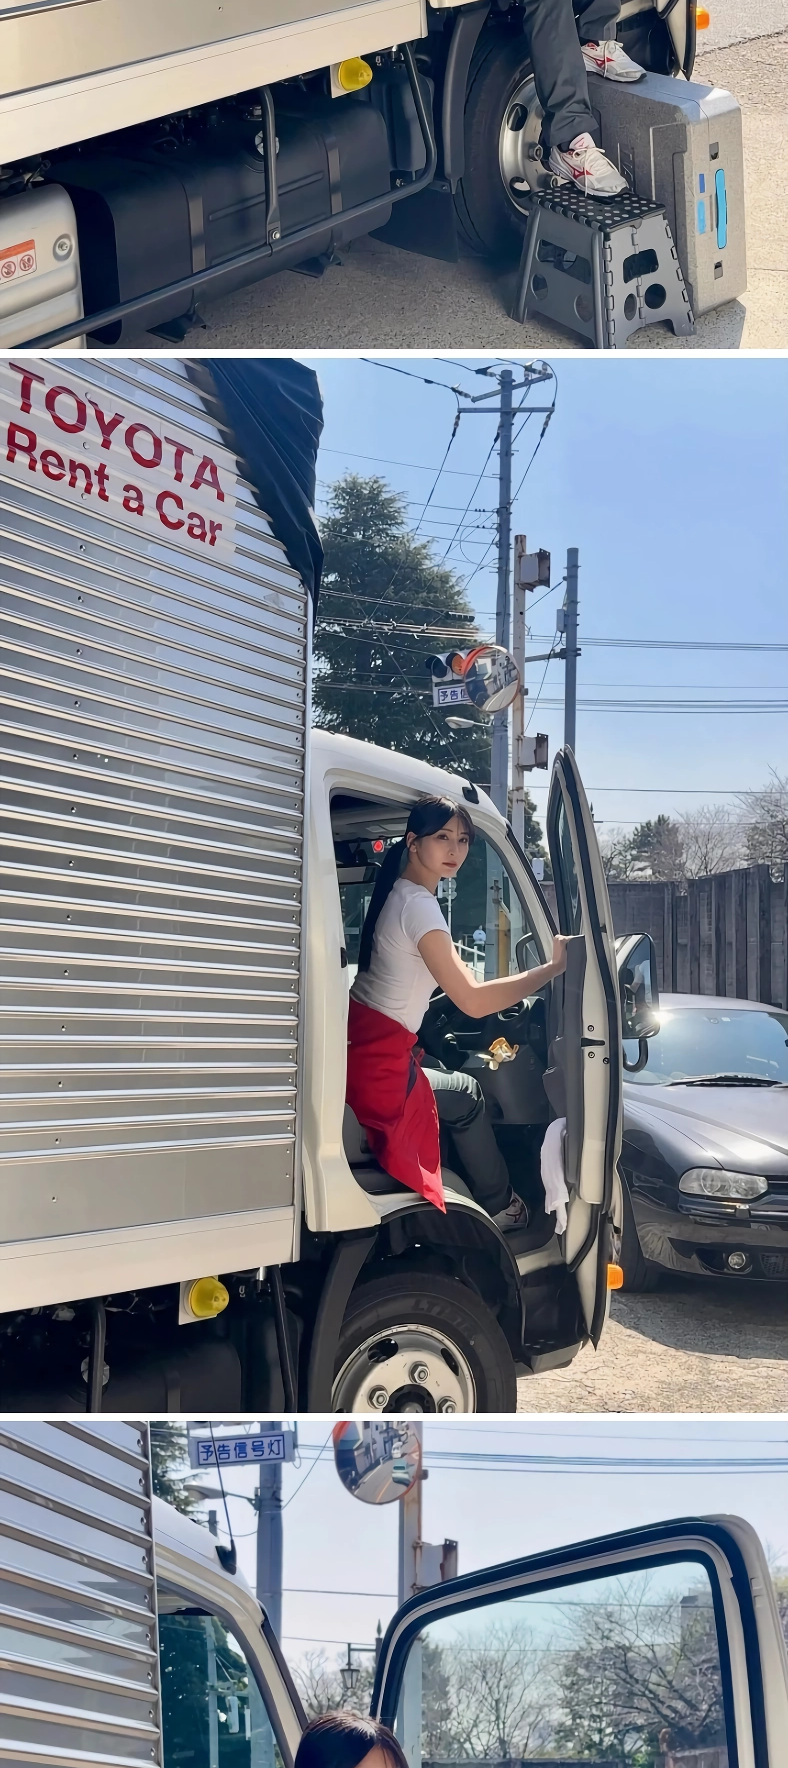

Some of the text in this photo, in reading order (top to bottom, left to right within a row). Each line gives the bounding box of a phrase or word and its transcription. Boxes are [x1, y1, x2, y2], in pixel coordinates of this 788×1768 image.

[6, 421, 222, 546] Rent a Car
[9, 362, 225, 502] TOYOTA
[200, 1439, 282, 1461] 予告信号灯
